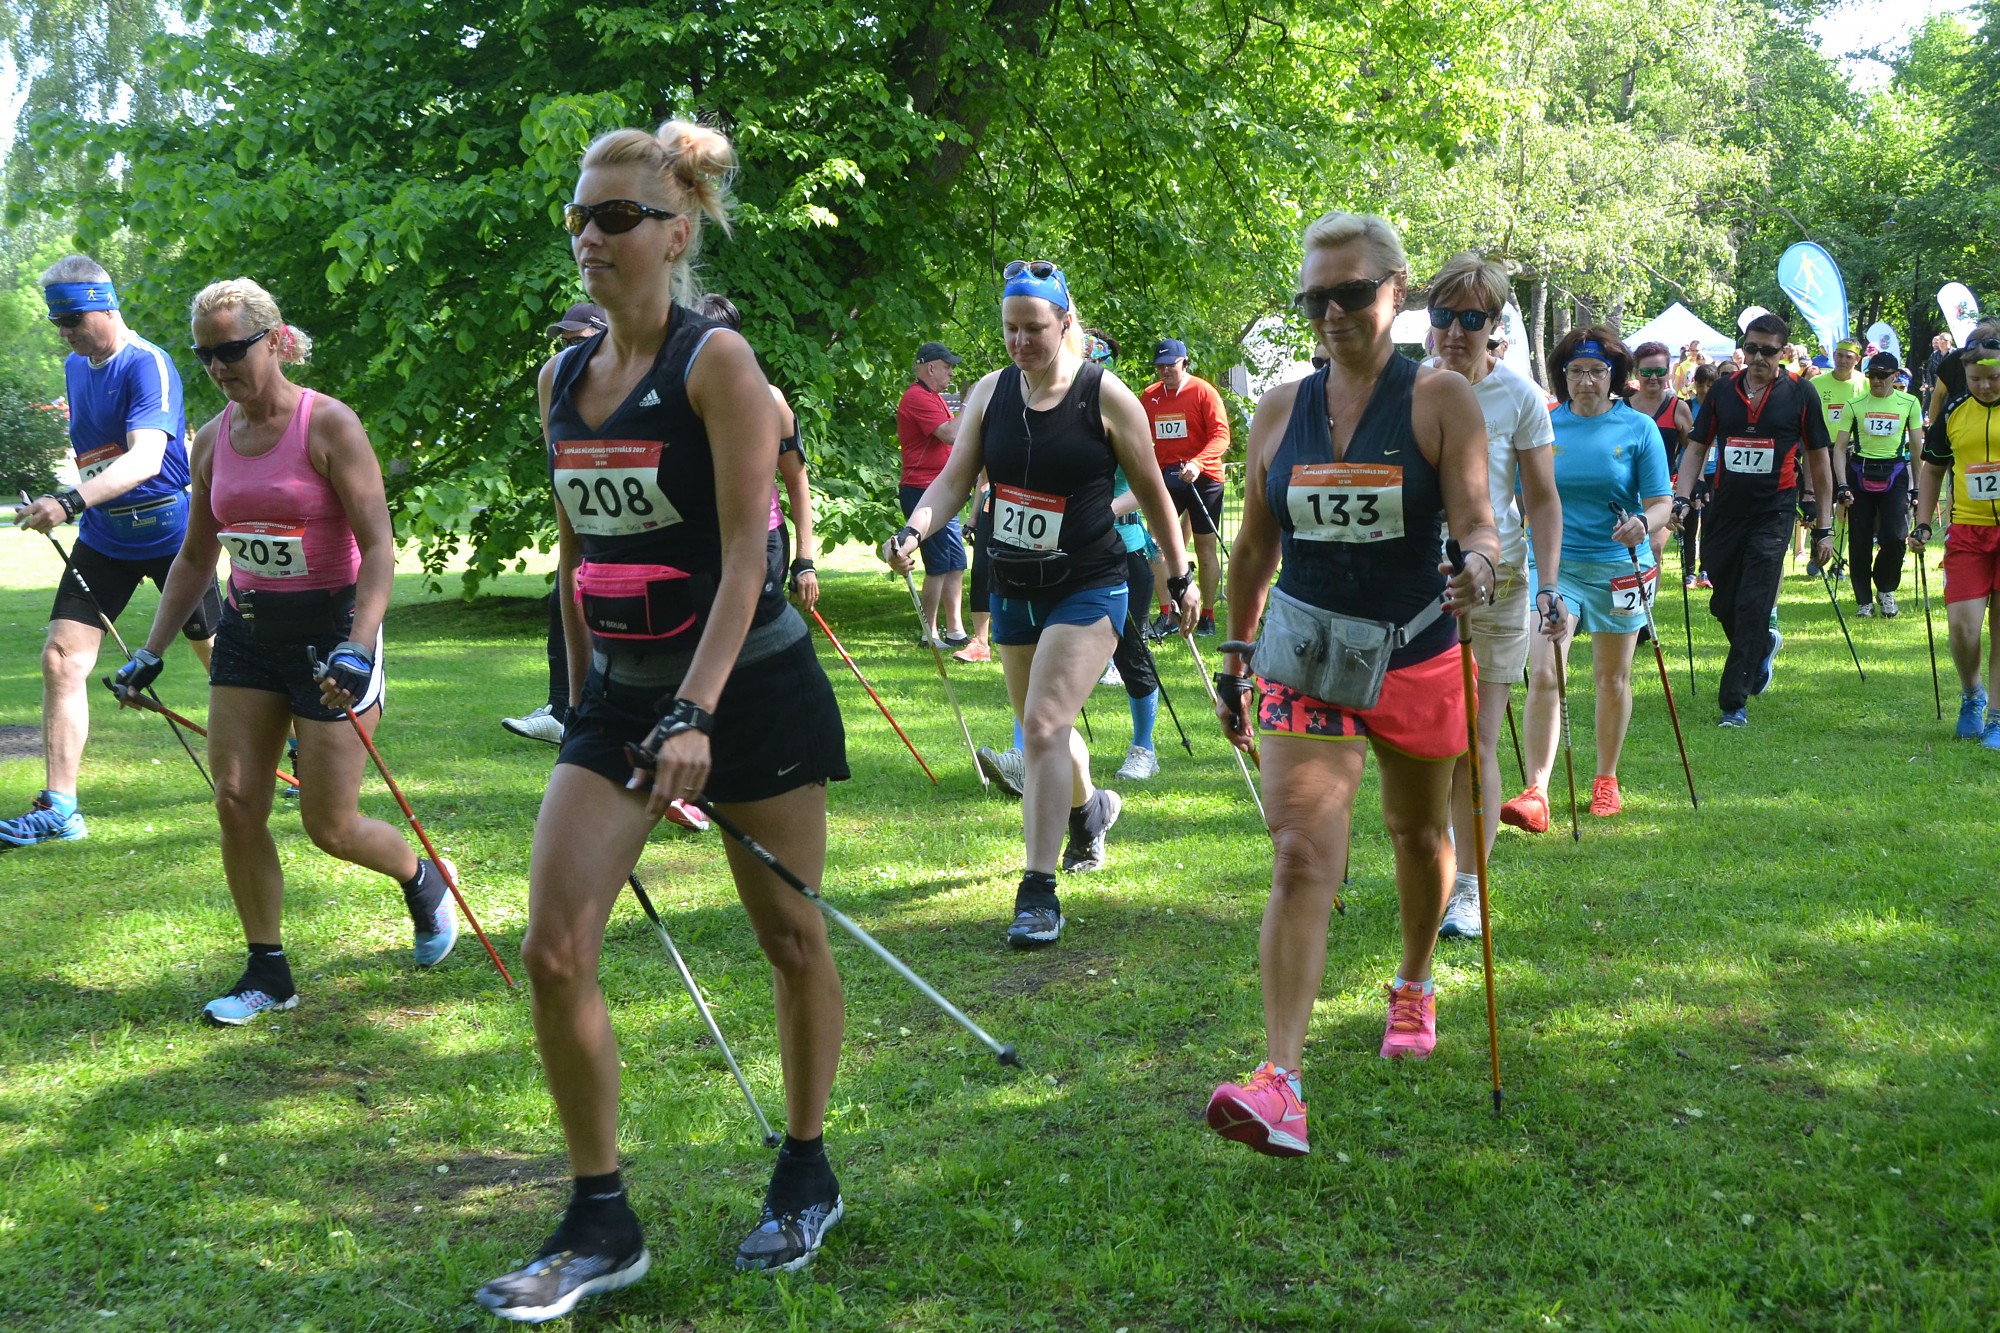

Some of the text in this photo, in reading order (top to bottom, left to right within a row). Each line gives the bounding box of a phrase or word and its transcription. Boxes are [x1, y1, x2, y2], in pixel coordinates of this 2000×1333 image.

[639, 397, 661, 407] adidas
[1160, 422, 1181, 434] 107
[1870, 420, 1892, 432] 134
[1732, 450, 1764, 466] 217
[1974, 475, 1998, 493] 12
[568, 477, 653, 518] 208
[1307, 494, 1380, 527] 133
[1003, 507, 1047, 539] 210
[231, 538, 292, 567] 203
